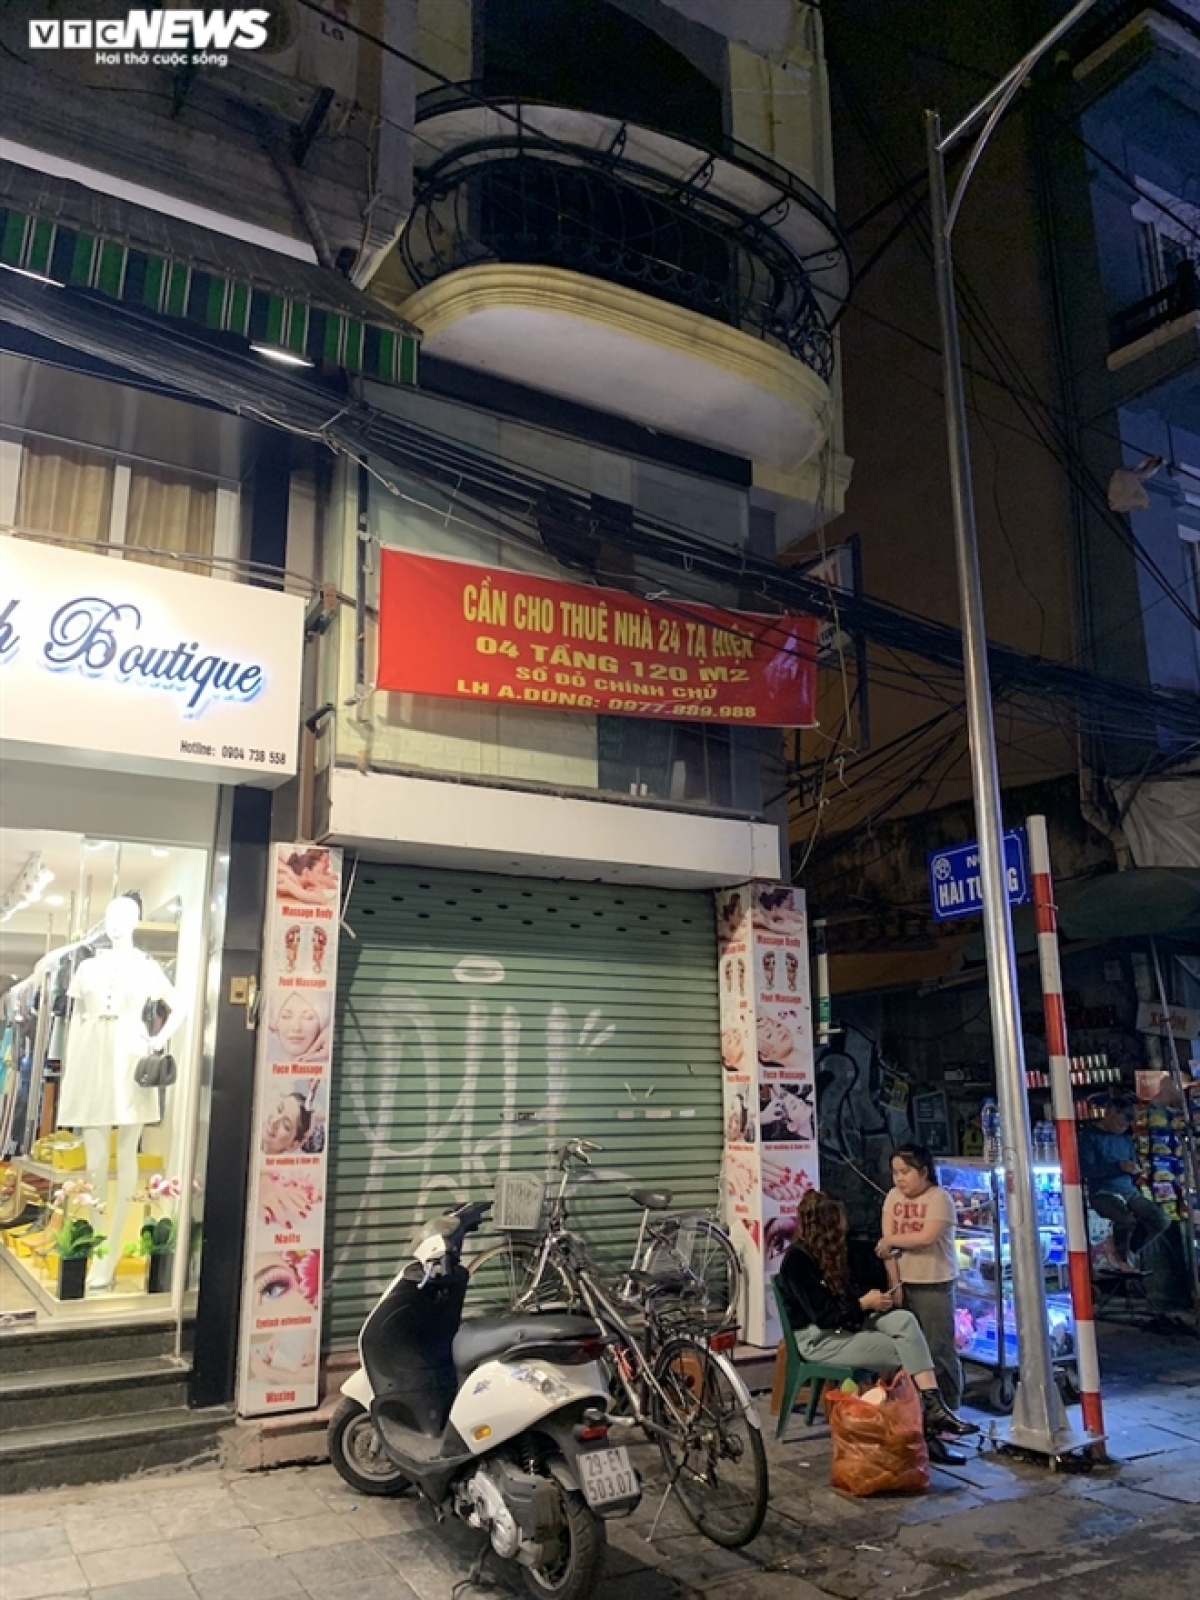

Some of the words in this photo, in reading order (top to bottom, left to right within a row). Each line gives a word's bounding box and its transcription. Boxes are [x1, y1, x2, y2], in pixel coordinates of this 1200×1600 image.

[514, 593, 554, 634] CHO
[560, 600, 608, 643] THUÊ
[614, 608, 654, 651] NHÀ
[658, 618, 681, 655] 24
[44, 597, 262, 708] Boutique
[476, 635, 520, 659] 04
[630, 661, 688, 683] 120
[698, 666, 750, 683] M2
[457, 679, 490, 696] LH
